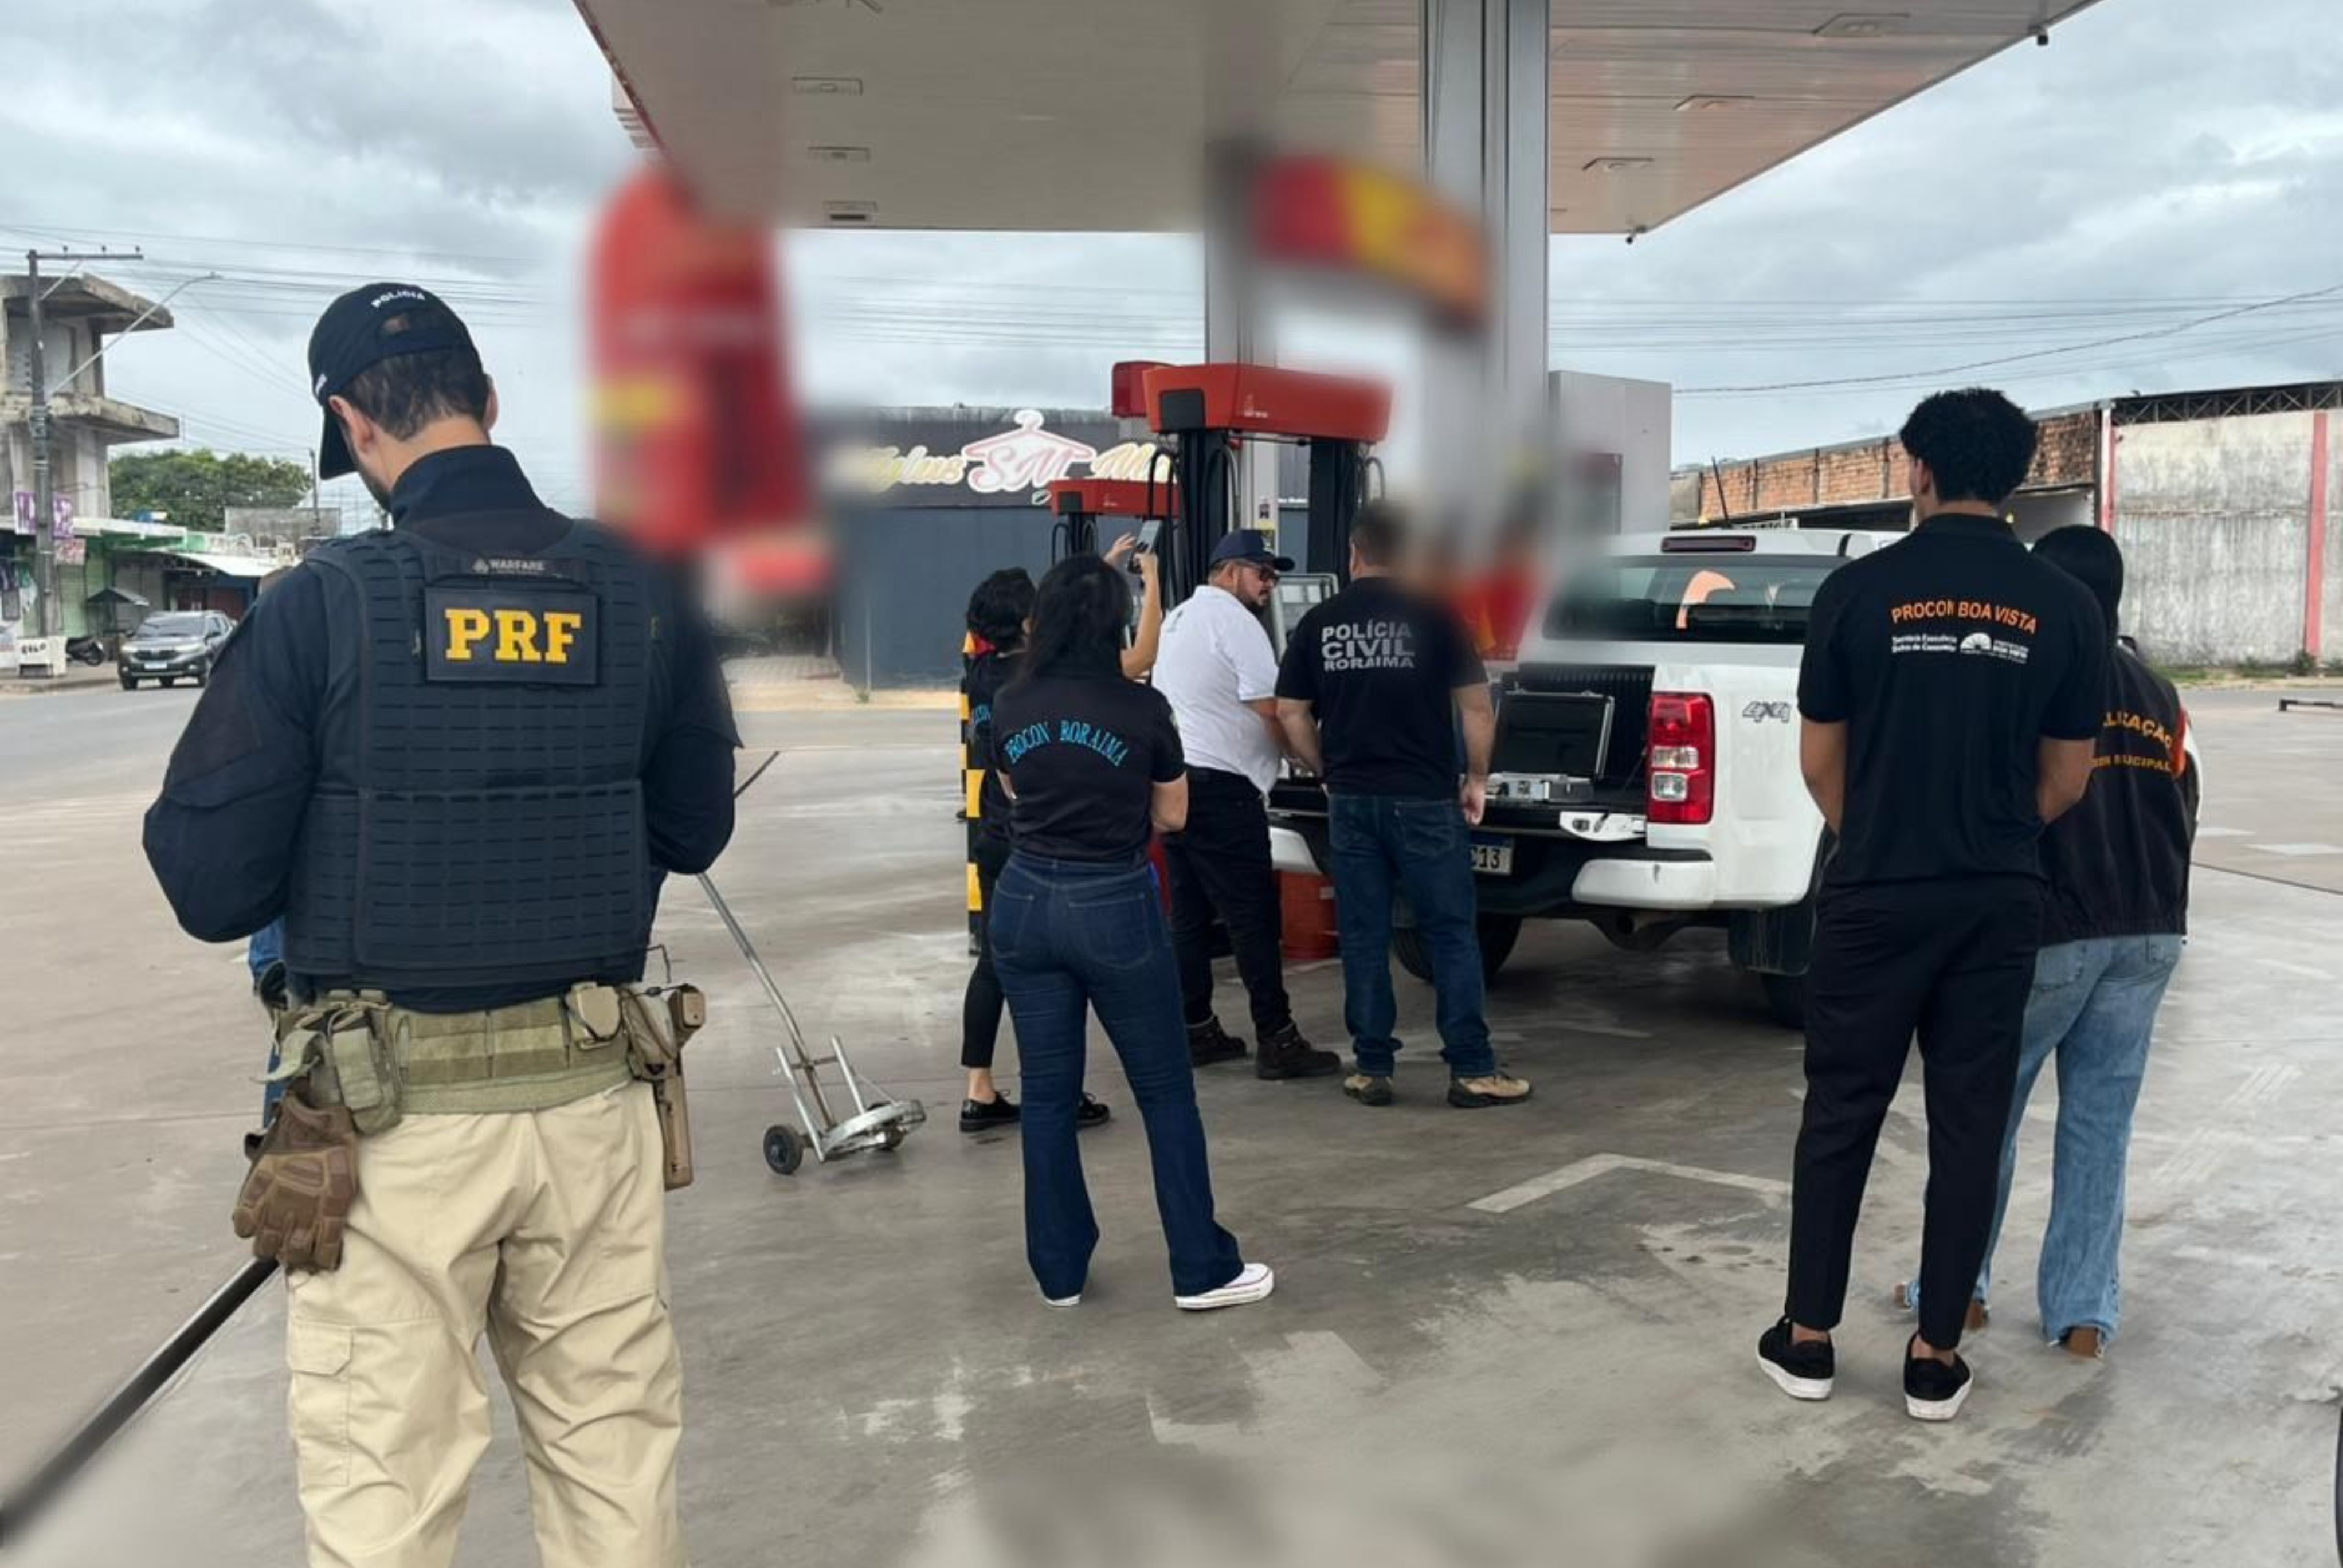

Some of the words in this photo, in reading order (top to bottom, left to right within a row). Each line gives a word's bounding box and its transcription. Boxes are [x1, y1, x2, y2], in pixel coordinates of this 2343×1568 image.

[1322, 618, 1412, 643] POLÍCIA
[1891, 599, 1954, 624] PROCON
[1958, 601, 1992, 619] BOA
[1994, 605, 2037, 634] VISTA
[444, 607, 581, 663] PRF
[1321, 638, 1416, 660] CIVIL
[1324, 656, 1415, 672] RORAIMA
[1059, 719, 1129, 767] RORAIMA
